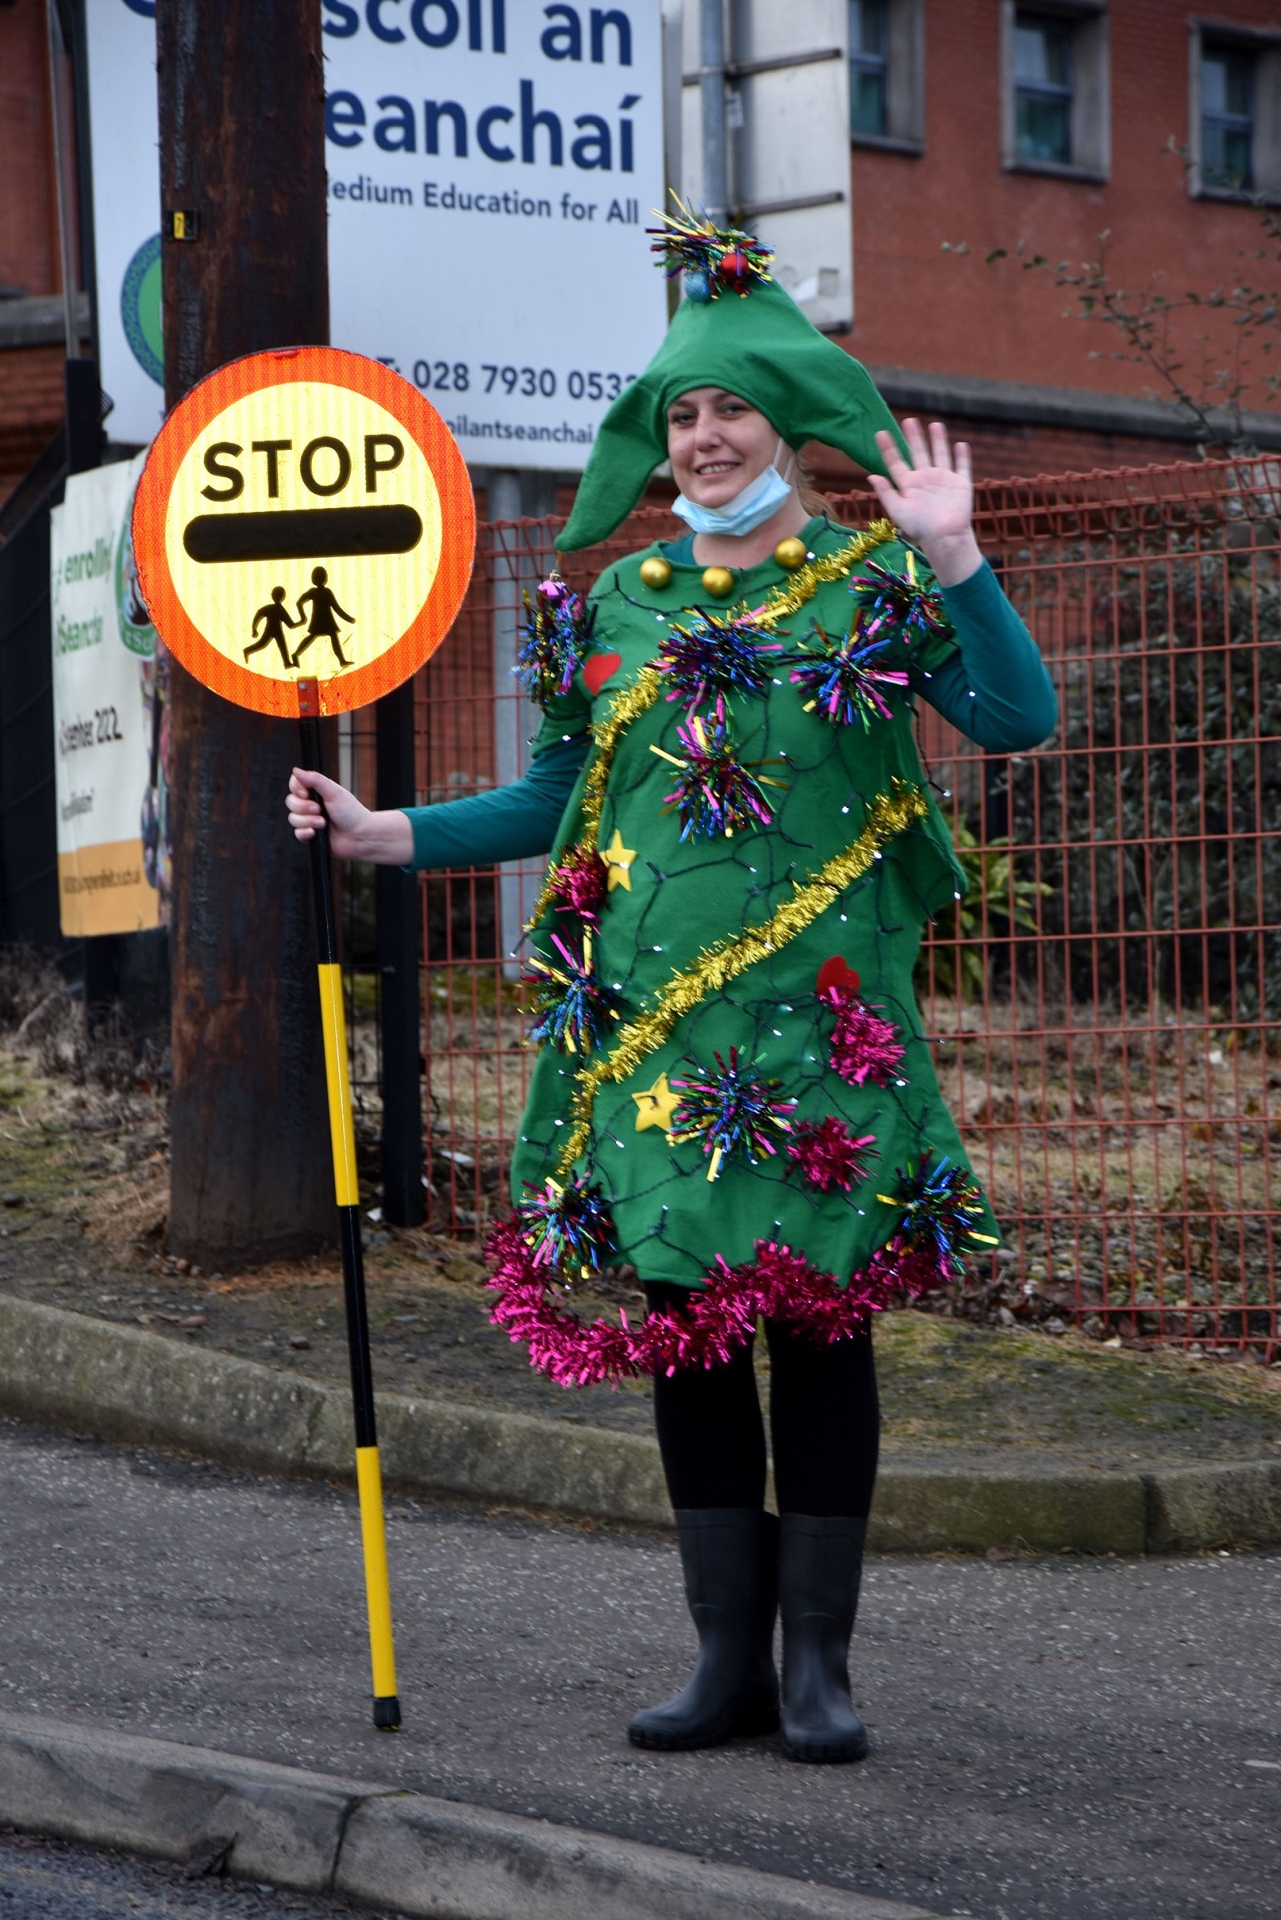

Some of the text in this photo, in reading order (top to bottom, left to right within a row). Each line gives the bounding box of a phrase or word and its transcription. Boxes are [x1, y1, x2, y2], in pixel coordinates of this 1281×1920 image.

[540, 4, 633, 66] an
[327, 175, 639, 224] edium Education for All
[413, 359, 469, 390] 028
[481, 364, 556, 397] 7930
[200, 434, 405, 502] STOP
